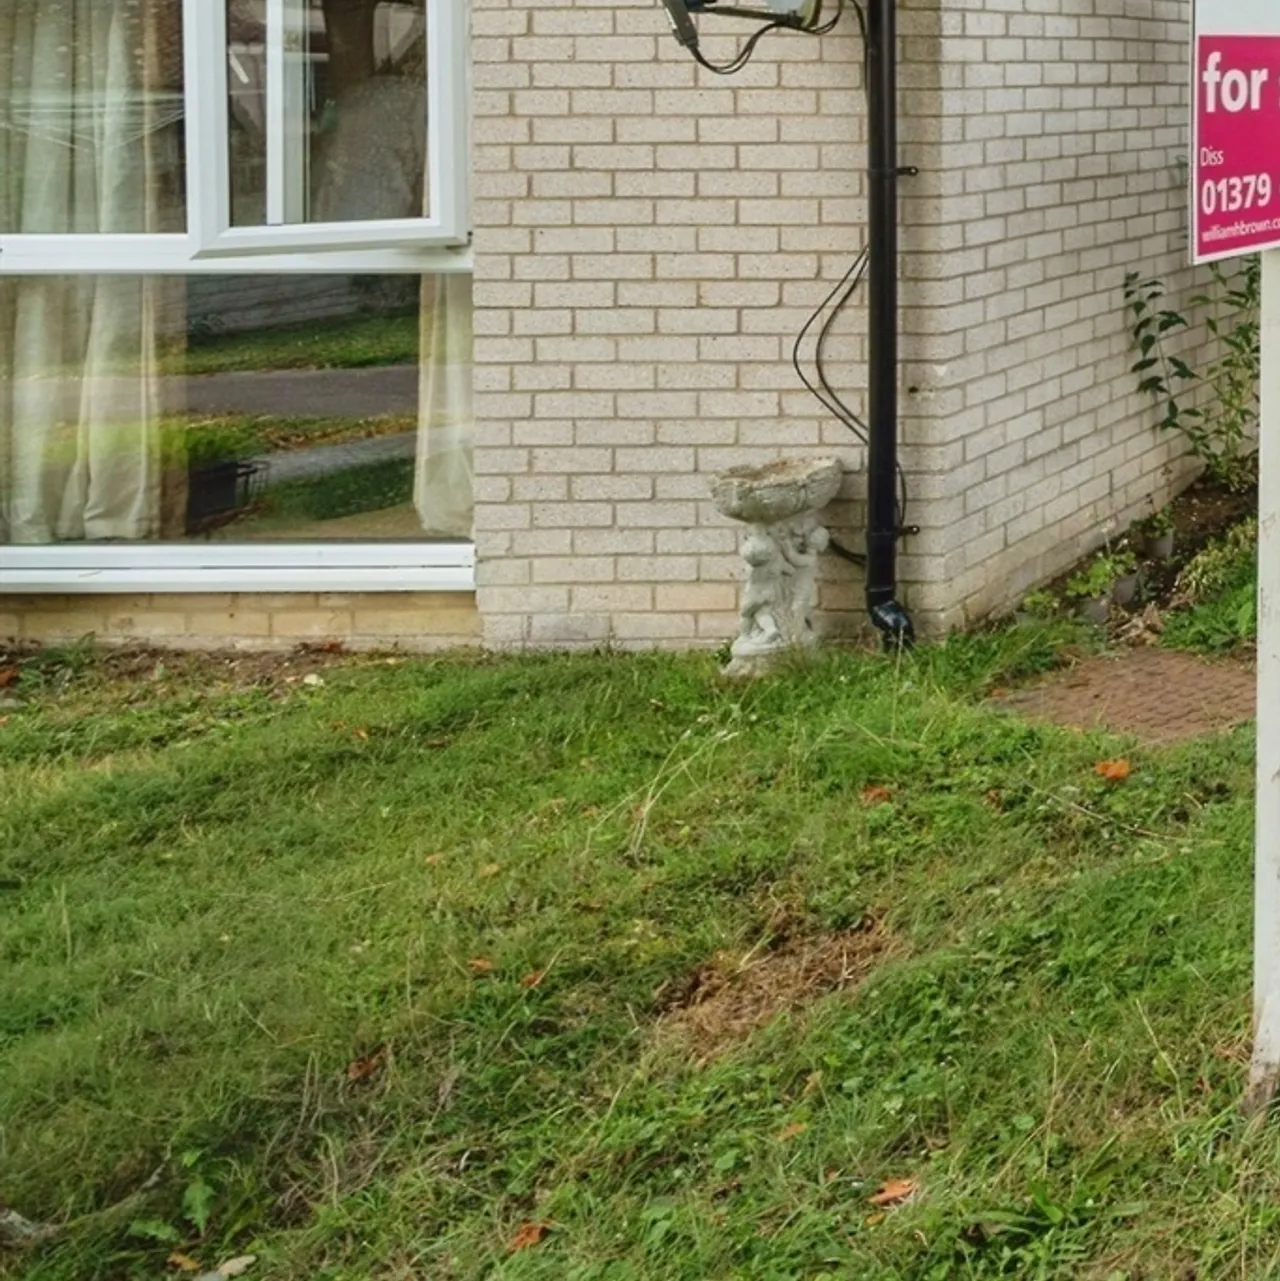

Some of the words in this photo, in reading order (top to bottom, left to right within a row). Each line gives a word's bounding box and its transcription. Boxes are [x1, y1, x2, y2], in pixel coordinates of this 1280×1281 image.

[1202, 51, 1269, 113] for
[1200, 146, 1224, 167] Diss
[1201, 172, 1272, 215] 01379
